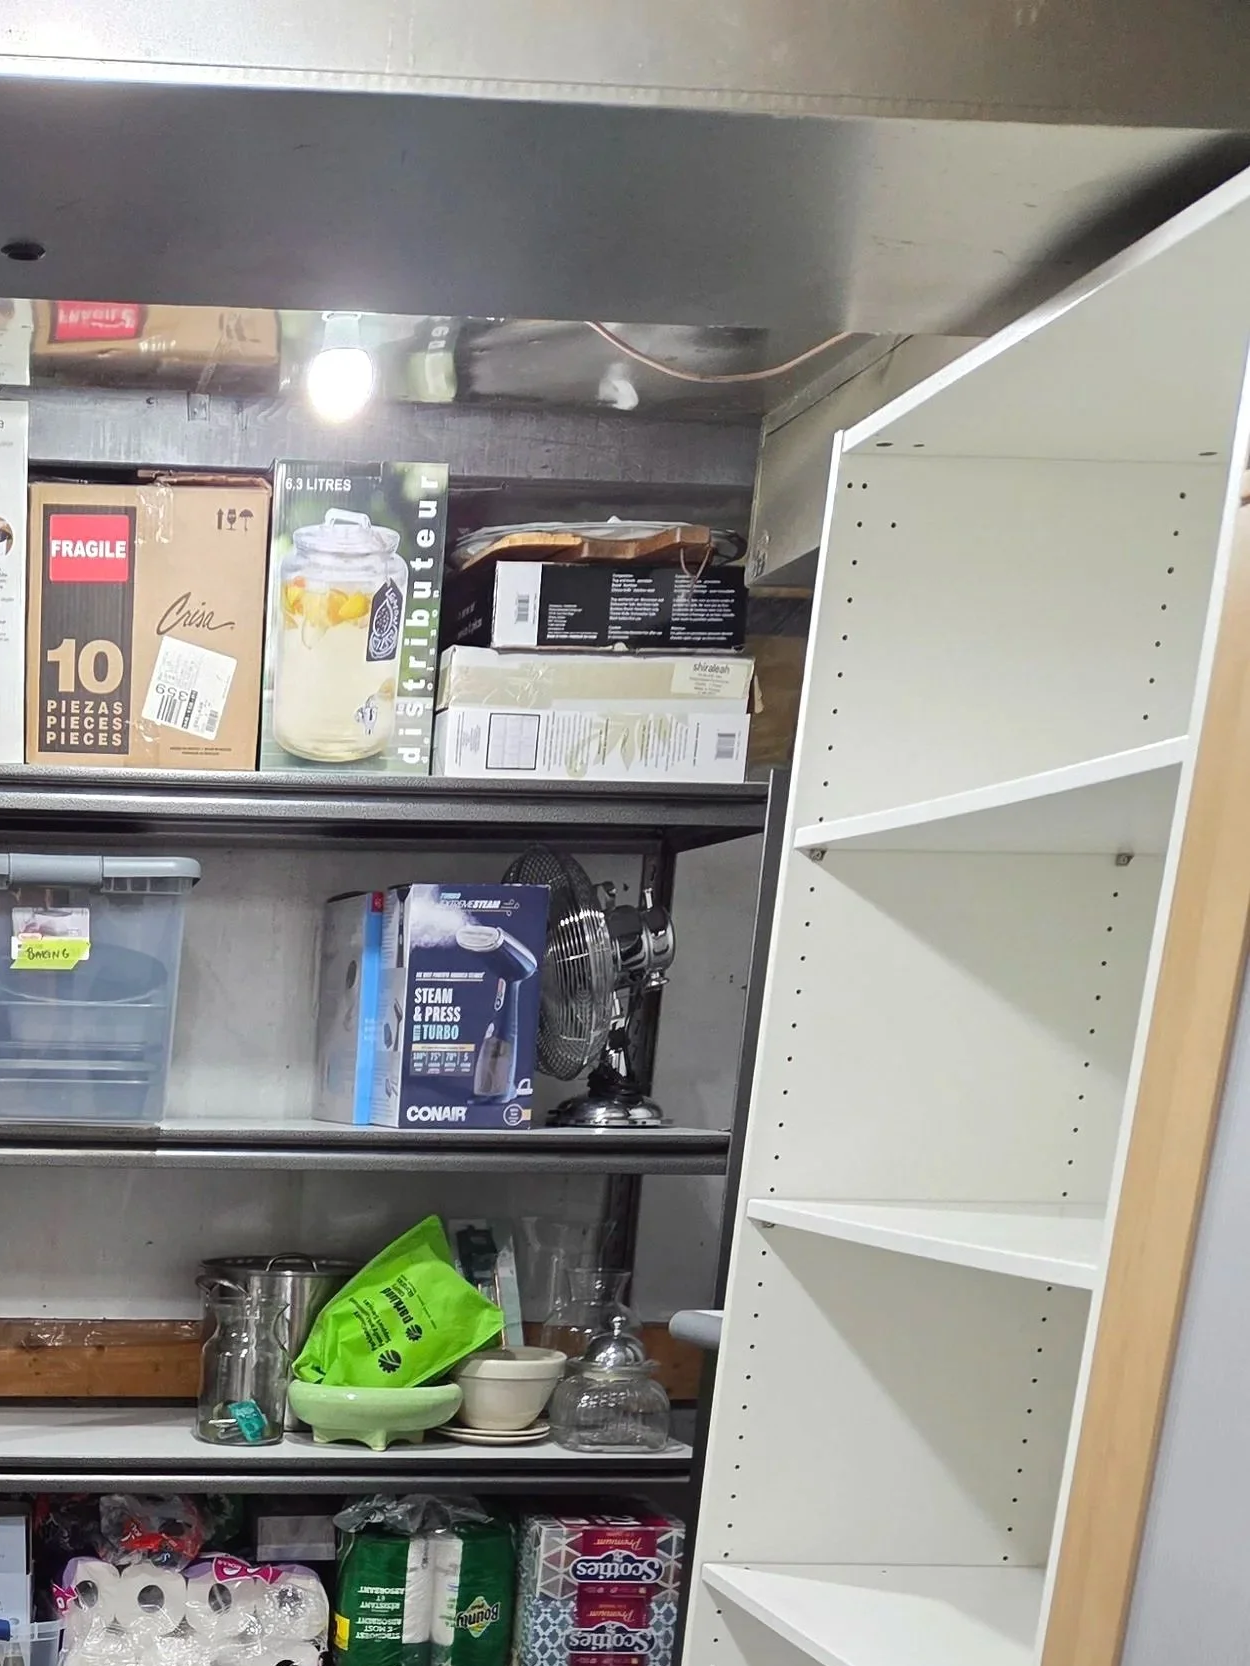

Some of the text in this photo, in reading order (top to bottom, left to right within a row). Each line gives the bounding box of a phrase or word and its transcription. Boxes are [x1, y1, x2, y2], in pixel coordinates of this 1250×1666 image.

[286, 478, 352, 491] 6.3 LITRES
[51, 540, 127, 558] FRAGILE
[157, 592, 236, 636] Crisa
[47, 638, 124, 694] 10
[46, 700, 123, 715] PIEZAS
[46, 717, 123, 731] PIECES
[46, 731, 123, 746] PIECES
[26, 947, 70, 961] BAKING
[414, 987, 453, 1004] STEAM
[413, 1006, 461, 1022] & PRESS
[422, 1024, 459, 1040] TURBO
[406, 1105, 467, 1122] CONAIR
[593, 1537, 643, 1552] Premium
[575, 1559, 661, 1583] Scotties
[455, 1601, 502, 1630] Bounty
[586, 1609, 635, 1623] Premium
[569, 1632, 651, 1653] Scotties
